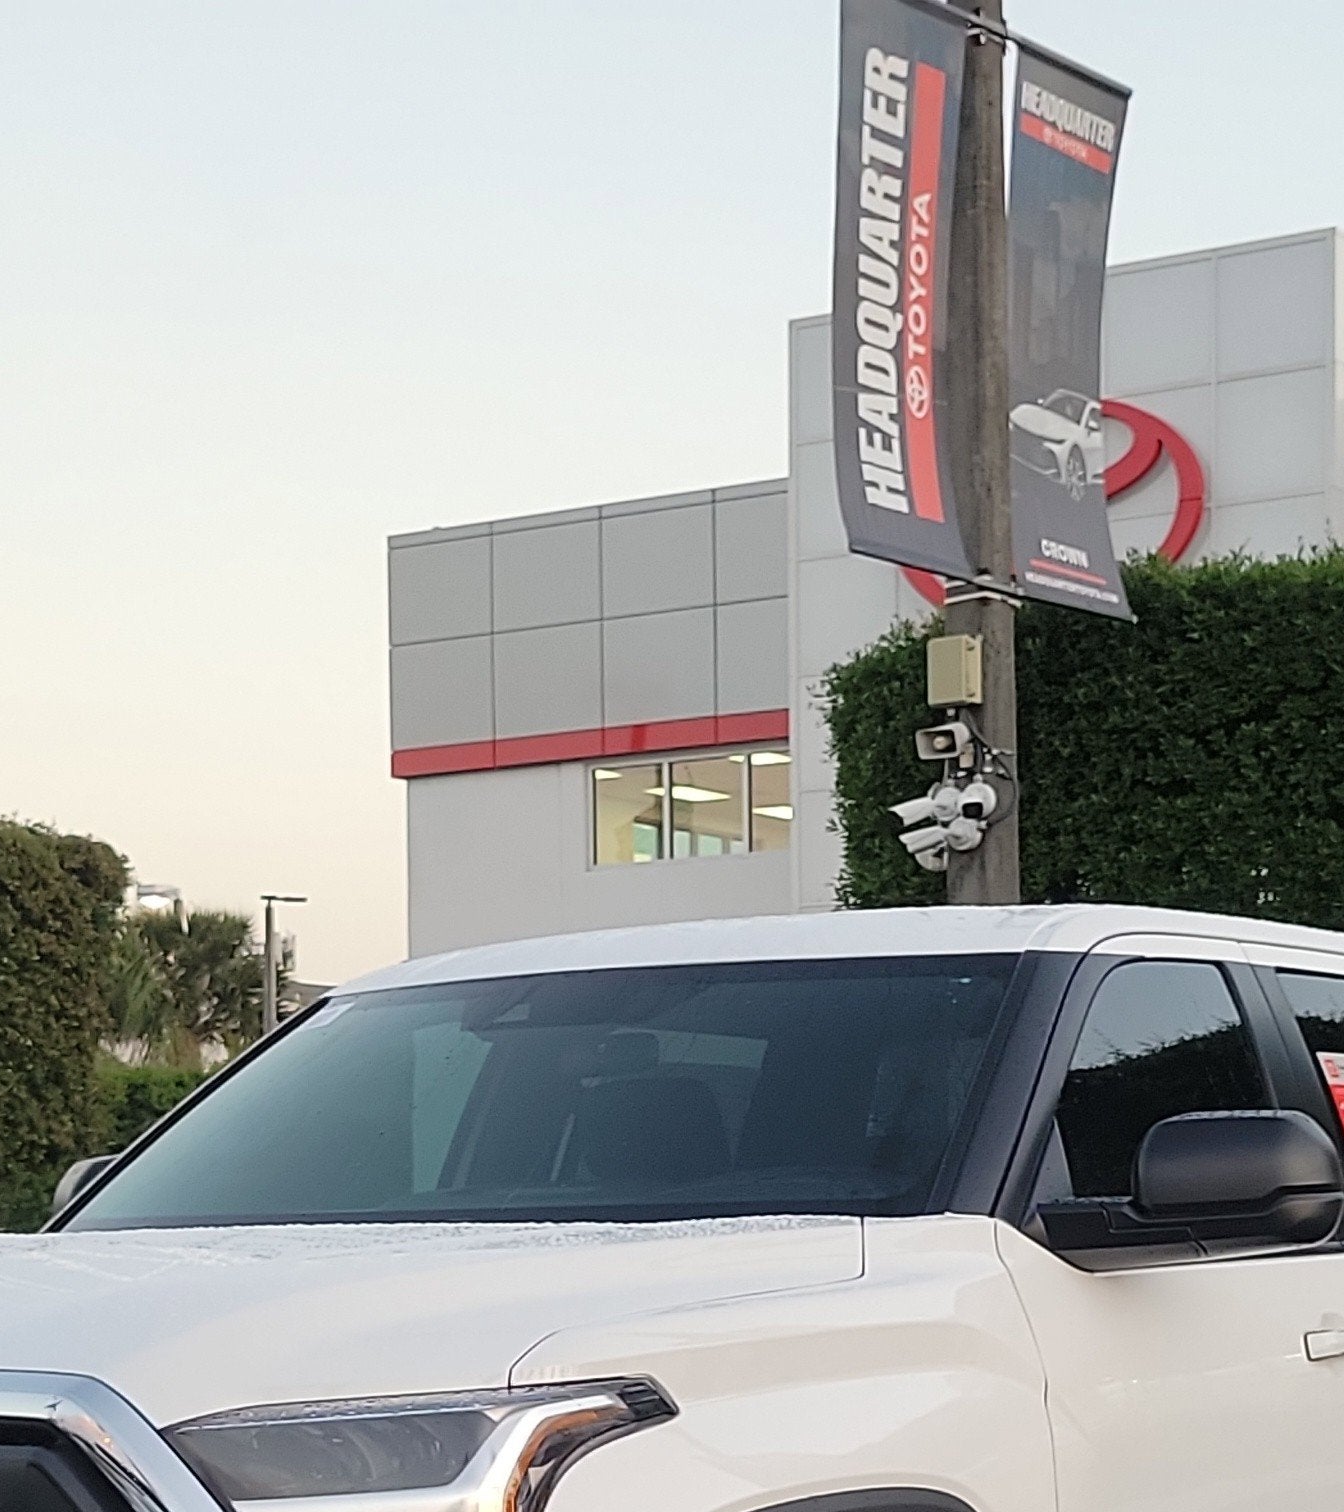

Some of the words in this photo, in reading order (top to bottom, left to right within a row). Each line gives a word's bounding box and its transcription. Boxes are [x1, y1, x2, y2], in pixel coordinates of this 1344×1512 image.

[857, 47, 909, 514] HEADQUARTER
[907, 193, 932, 359] TOYOTA
[1040, 538, 1089, 569] CROWN
